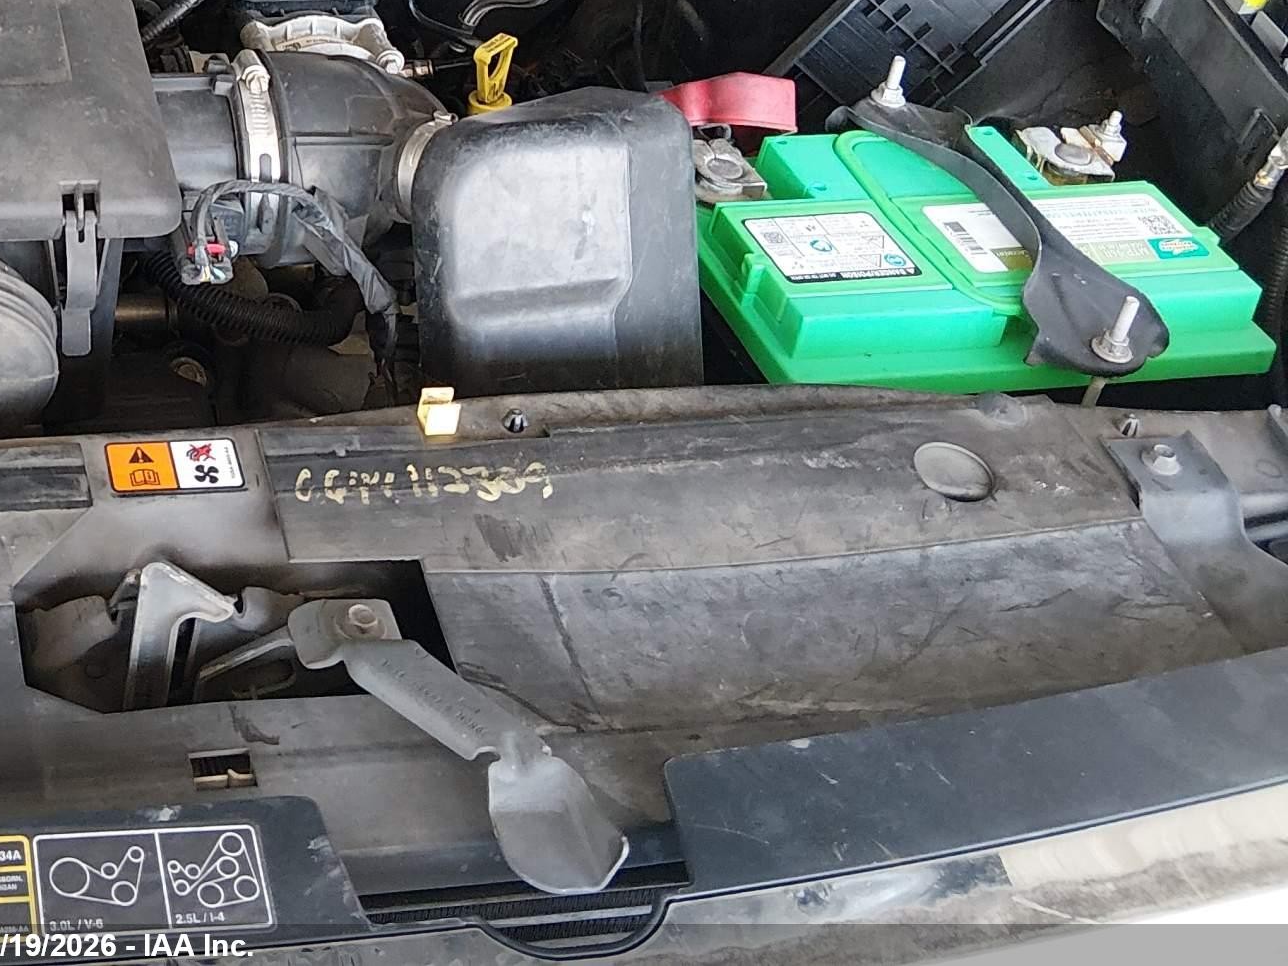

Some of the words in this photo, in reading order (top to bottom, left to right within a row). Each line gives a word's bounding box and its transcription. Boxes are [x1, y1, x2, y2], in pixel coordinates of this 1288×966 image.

[49, 920, 75, 931] 3.0L
[83, 918, 104, 930] V-6
[175, 913, 201, 925] 2.5L
[210, 911, 225, 922] I-4
